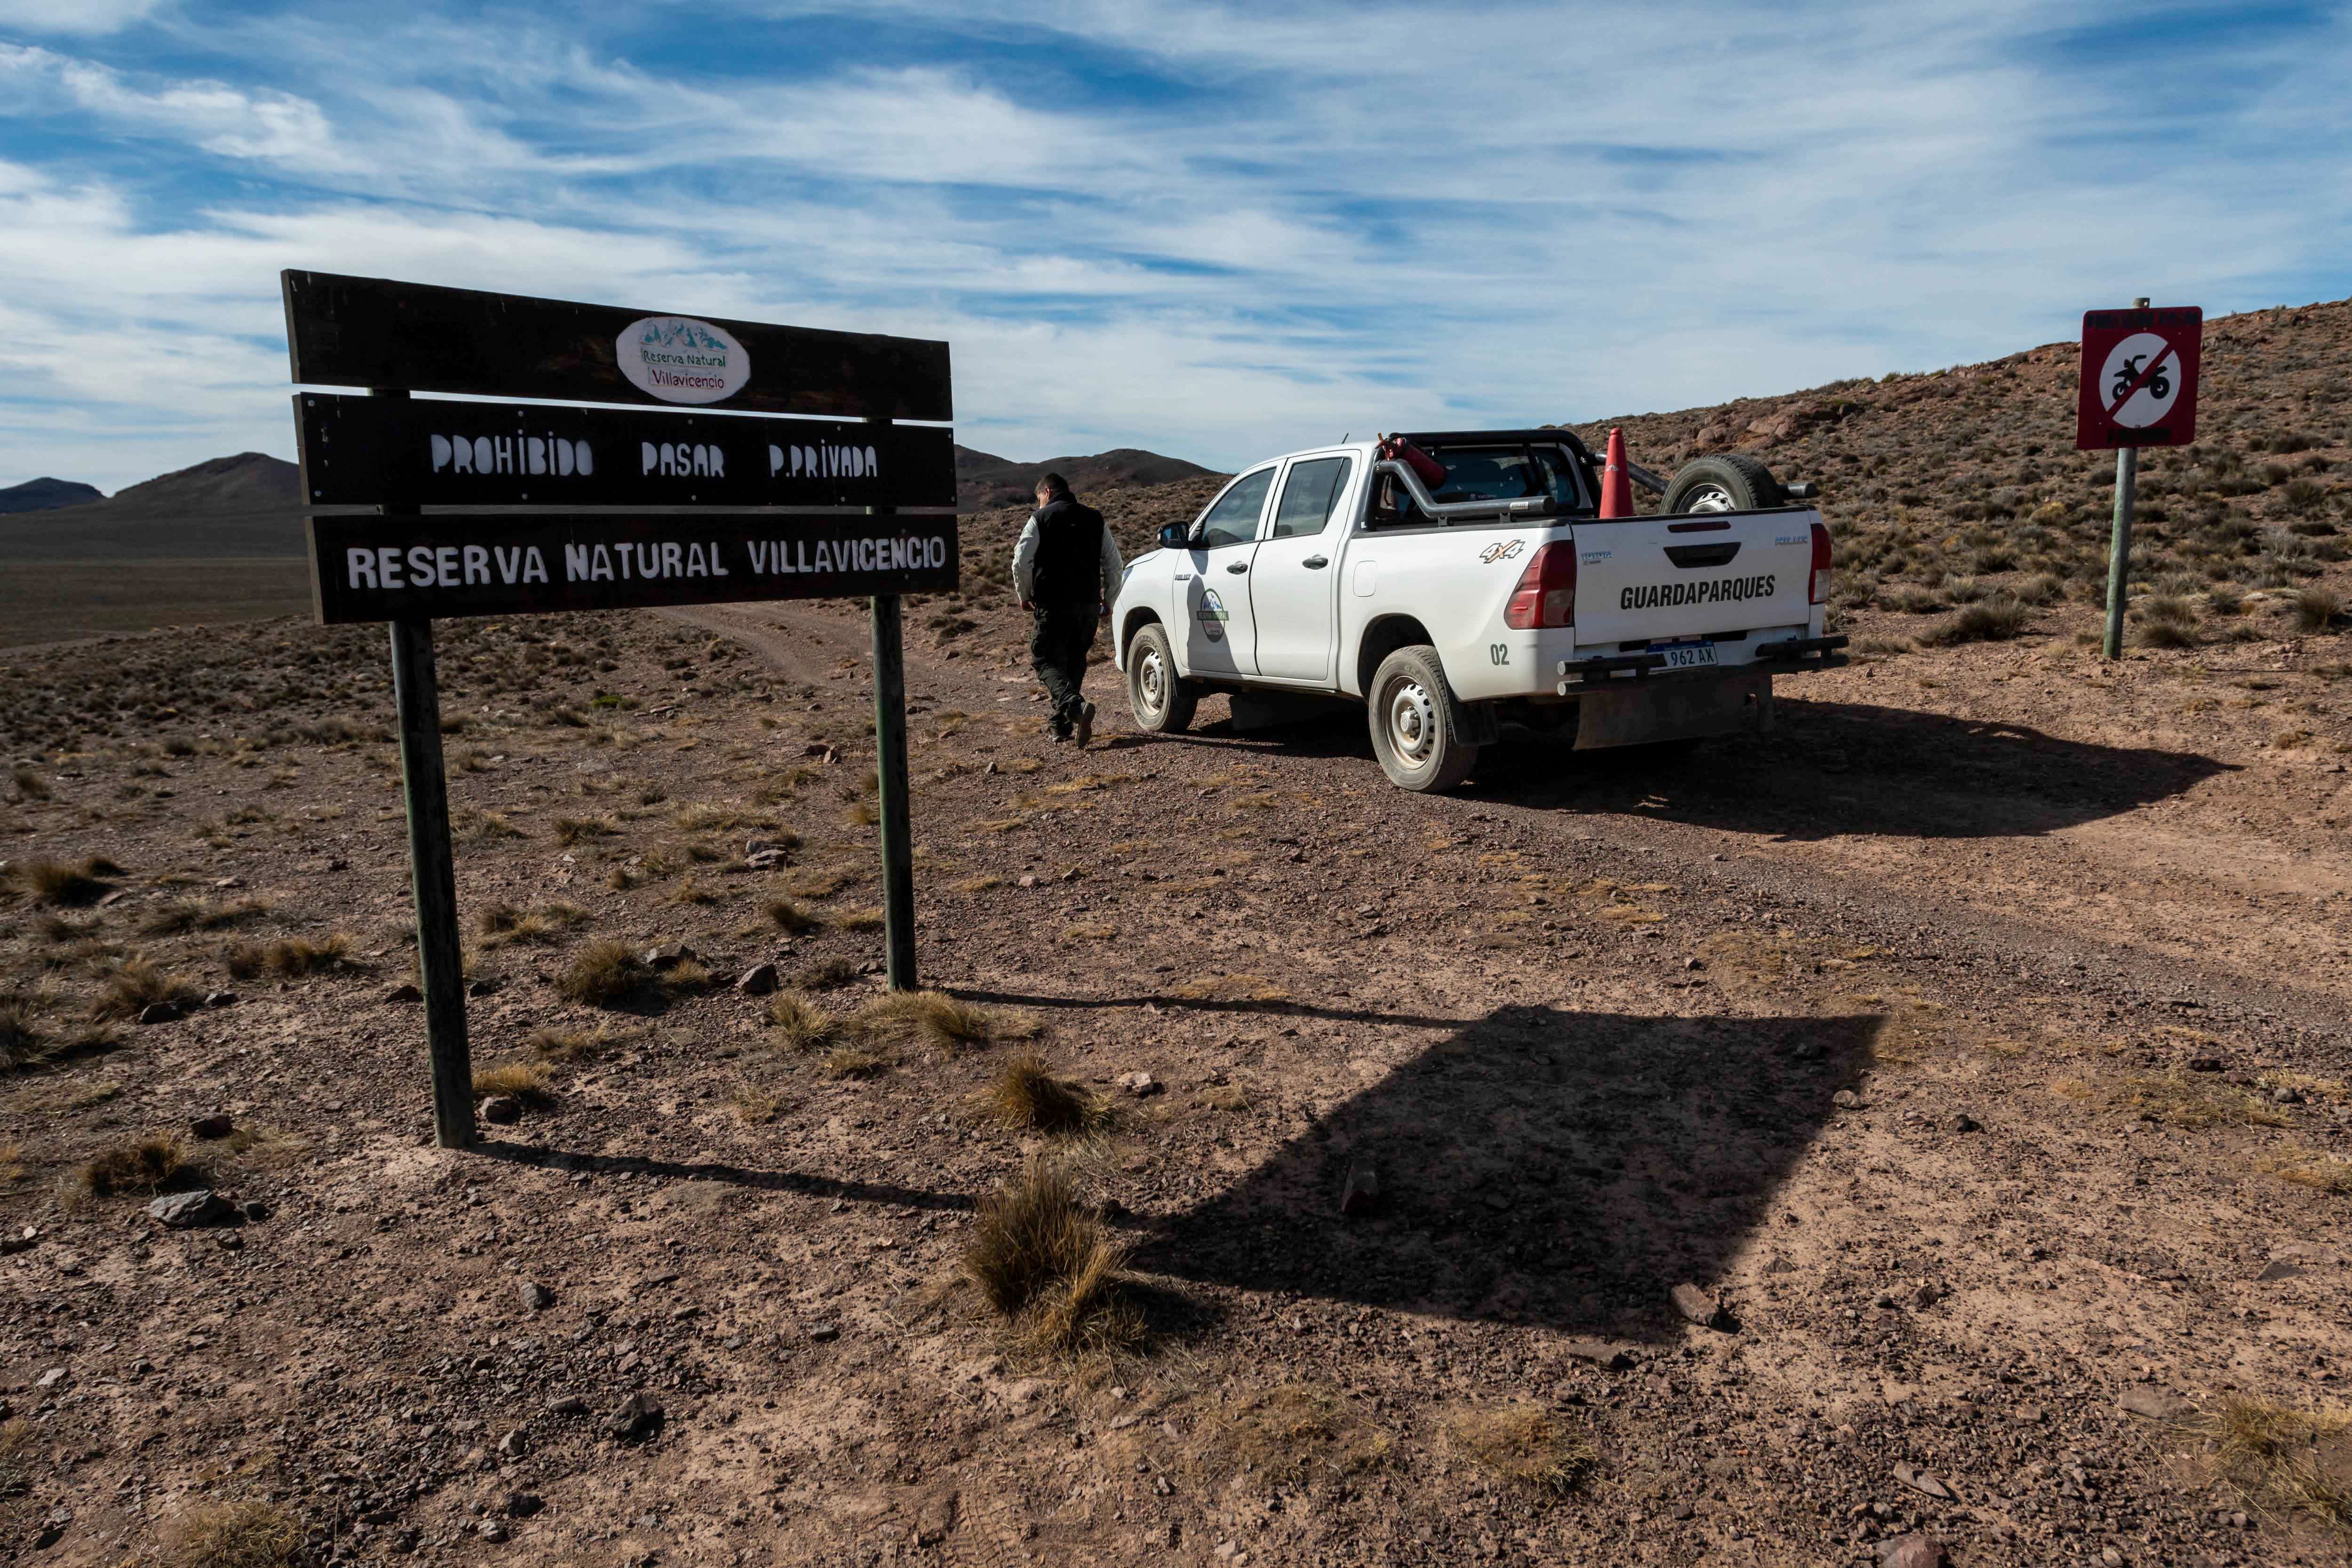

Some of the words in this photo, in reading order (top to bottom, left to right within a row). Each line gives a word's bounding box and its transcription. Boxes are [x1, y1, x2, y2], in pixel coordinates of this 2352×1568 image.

[643, 350, 683, 364] Reserva
[687, 355, 726, 367] Natural
[652, 369, 724, 388] Villavicencio
[642, 442, 724, 478] PASAR
[347, 545, 549, 589] RESERVA
[564, 542, 729, 582] NATURAL
[747, 536, 946, 574] VILLAVICENCIO
[1621, 575, 1776, 610] GUARDAPARQUES
[1490, 643, 1510, 666] 02
[1670, 650, 1695, 667] 962
[1698, 648, 1714, 663] AX
